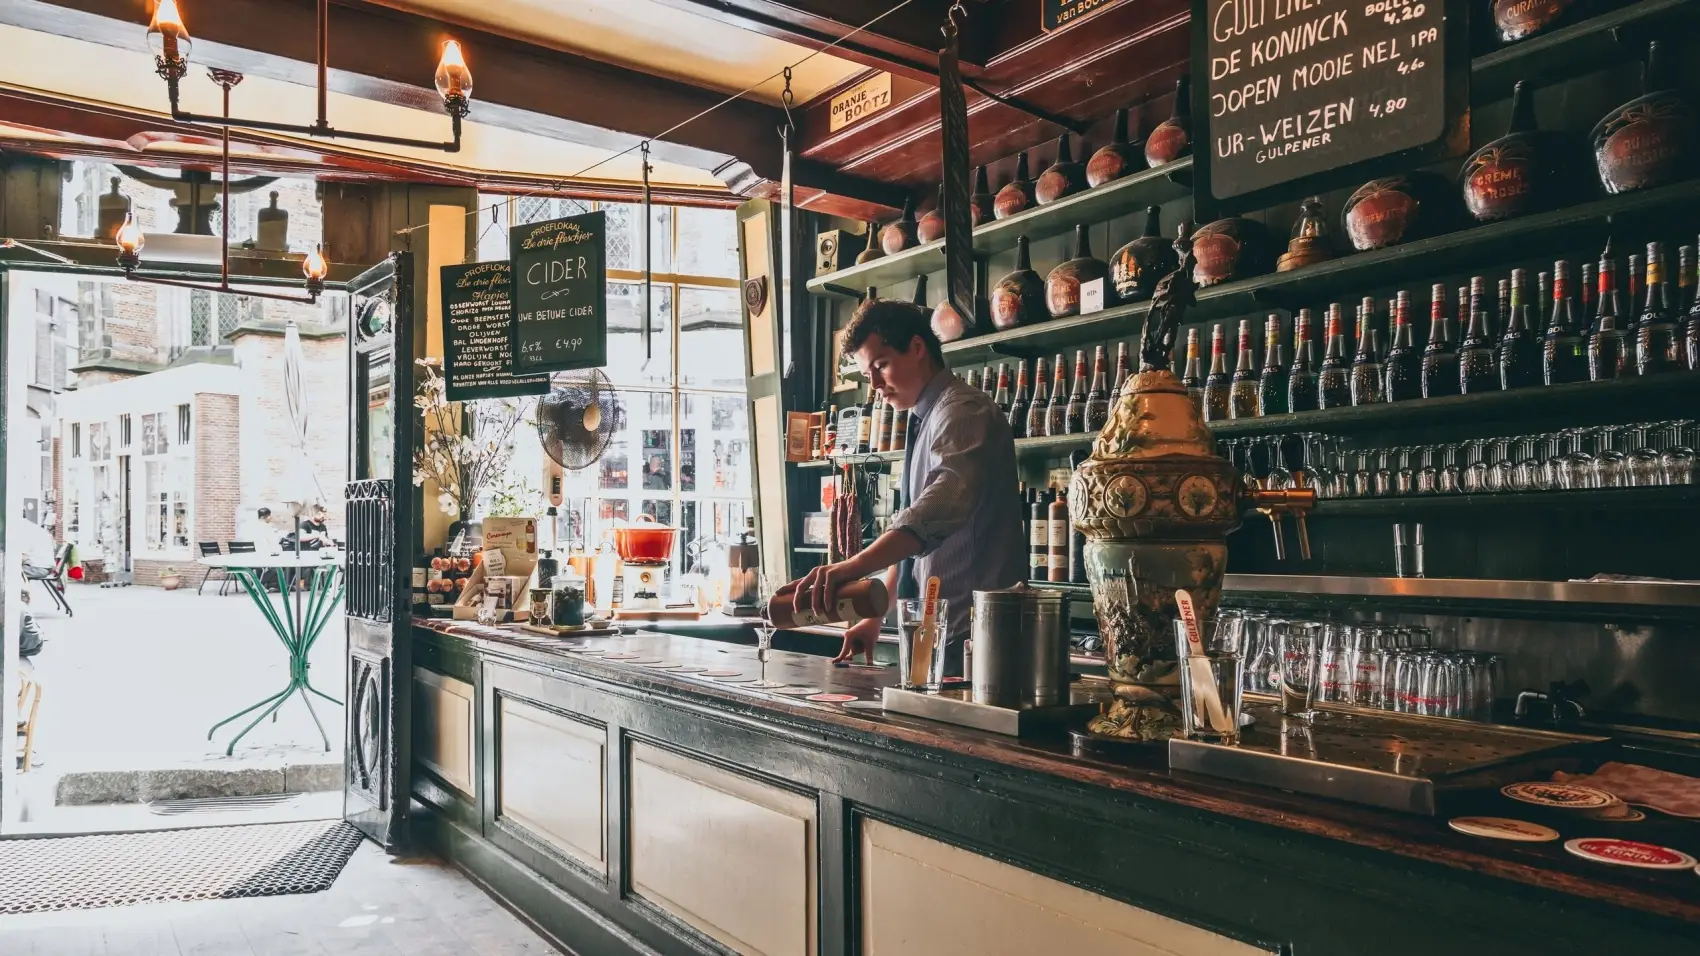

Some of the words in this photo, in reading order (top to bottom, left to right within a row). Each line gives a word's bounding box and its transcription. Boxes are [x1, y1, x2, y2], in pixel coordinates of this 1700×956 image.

[1057, 7, 1076, 23] van
[1384, 4, 1425, 25] 4.20
[1212, 49, 1241, 80] DE
[1251, 9, 1348, 67] KONINCK
[1212, 74, 1281, 117] JOPEN
[1292, 53, 1353, 91] MOOIE
[1362, 38, 1401, 68] NEL
[1411, 27, 1438, 48] IPA
[832, 90, 867, 115] ORANJE
[845, 91, 889, 122] BOOTZ
[1217, 97, 1354, 158] UR-WEIZEN
[1368, 97, 1407, 118] 4.80
[1255, 132, 1332, 164] GULPENER
[530, 221, 581, 239] PROEFLOKAAL
[527, 256, 588, 285] CIDER
[569, 305, 593, 317] CIDER
[486, 319, 511, 329] WORST
[461, 344, 509, 353] LEVERWORST
[521, 341, 542, 353] 6.5%
[1181, 600, 1200, 643] GULPENER
